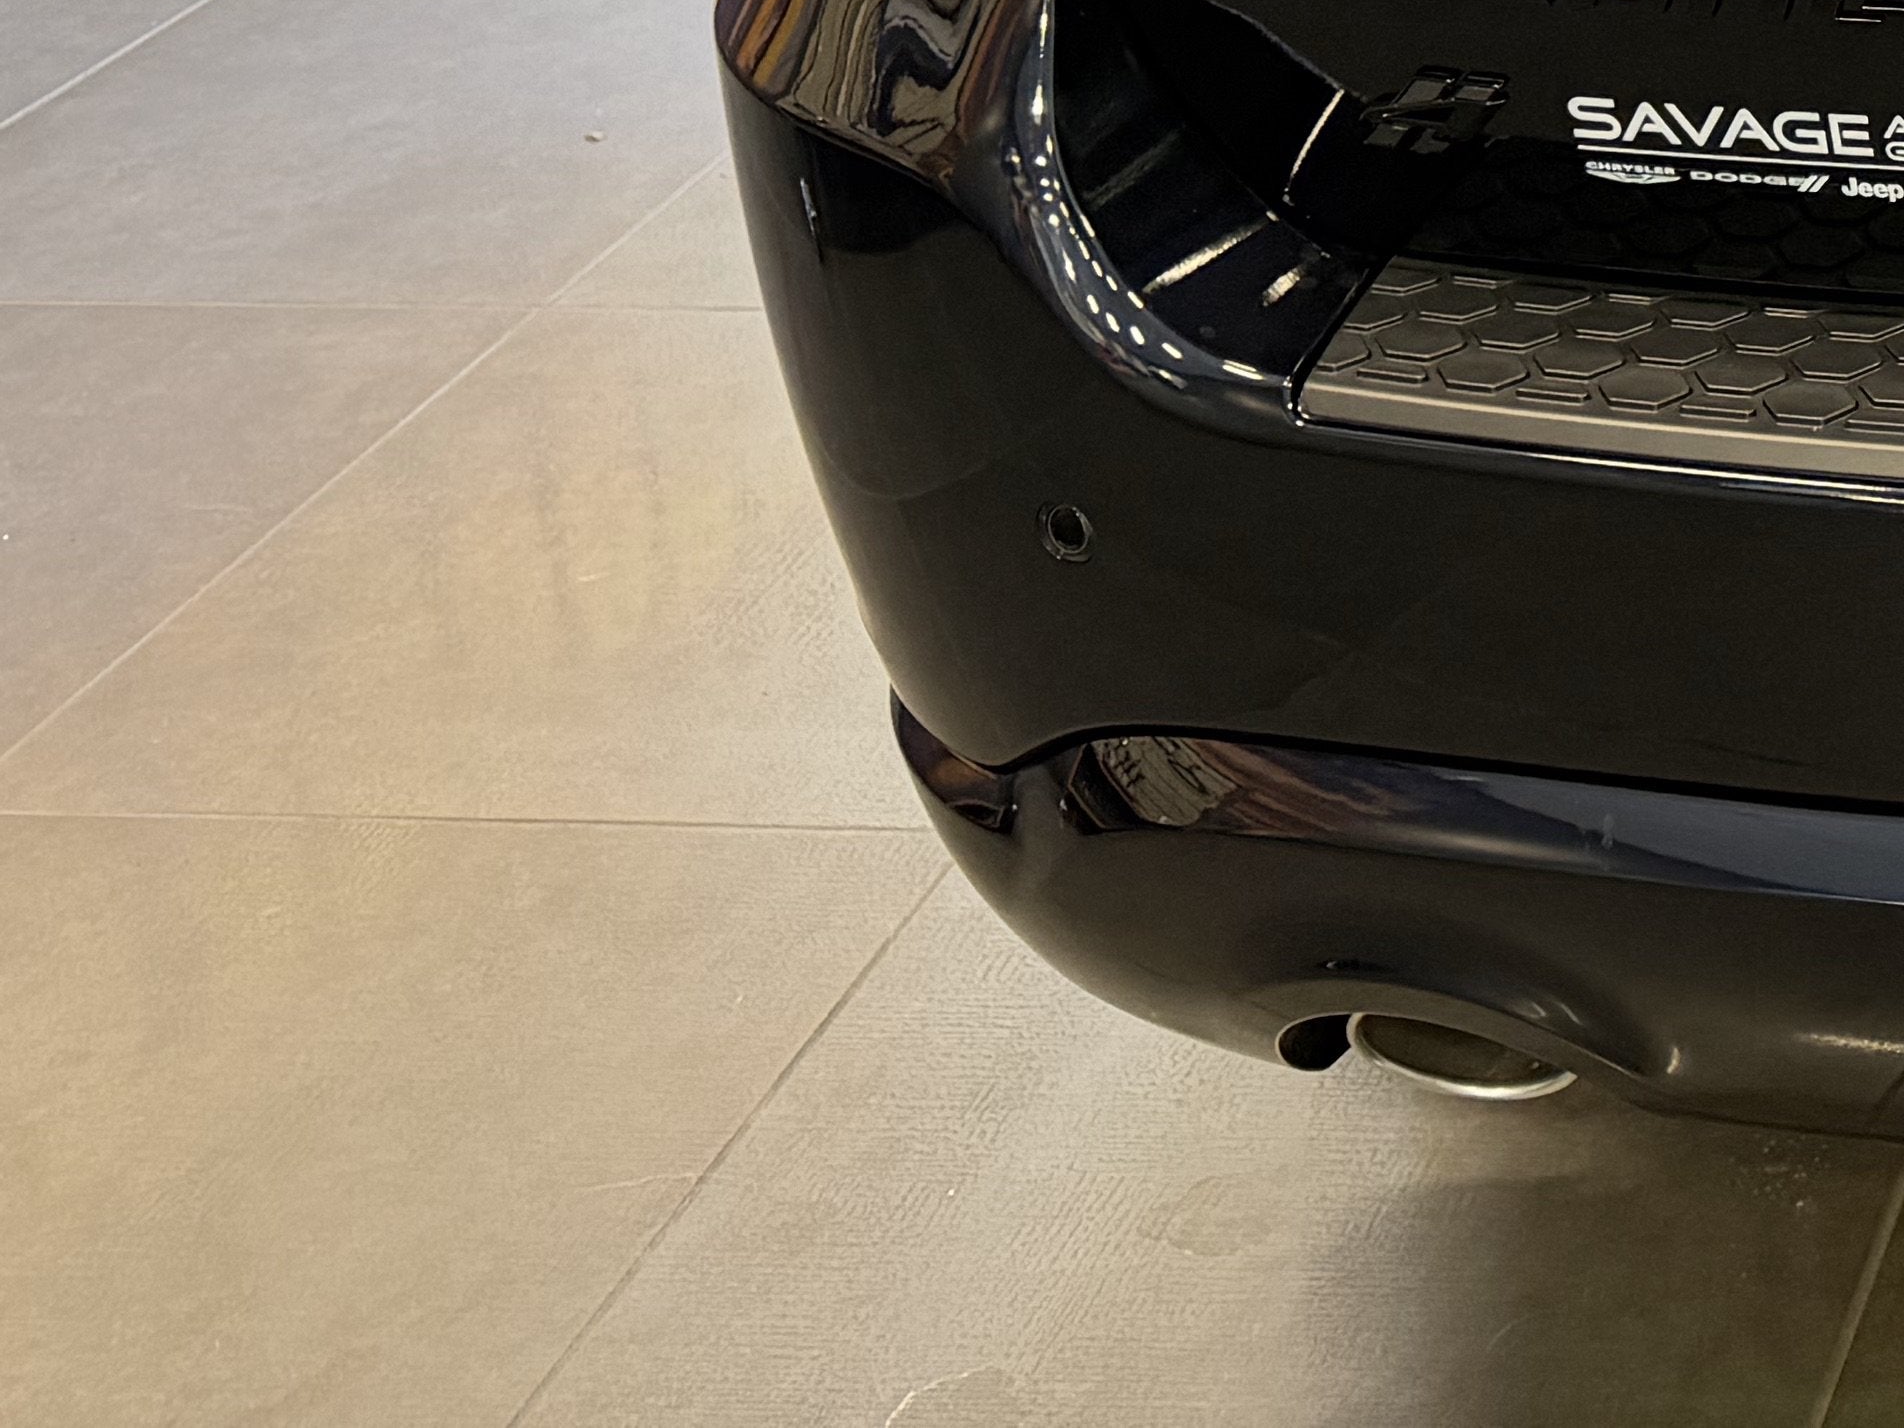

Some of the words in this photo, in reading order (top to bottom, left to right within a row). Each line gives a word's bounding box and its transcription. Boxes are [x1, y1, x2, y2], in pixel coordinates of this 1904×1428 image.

[1567, 96, 1875, 156] SAVAGE
[1585, 161, 1676, 175] CHRYSLER
[1690, 171, 1806, 187] DODGE
[1841, 177, 1904, 203] Jeep
